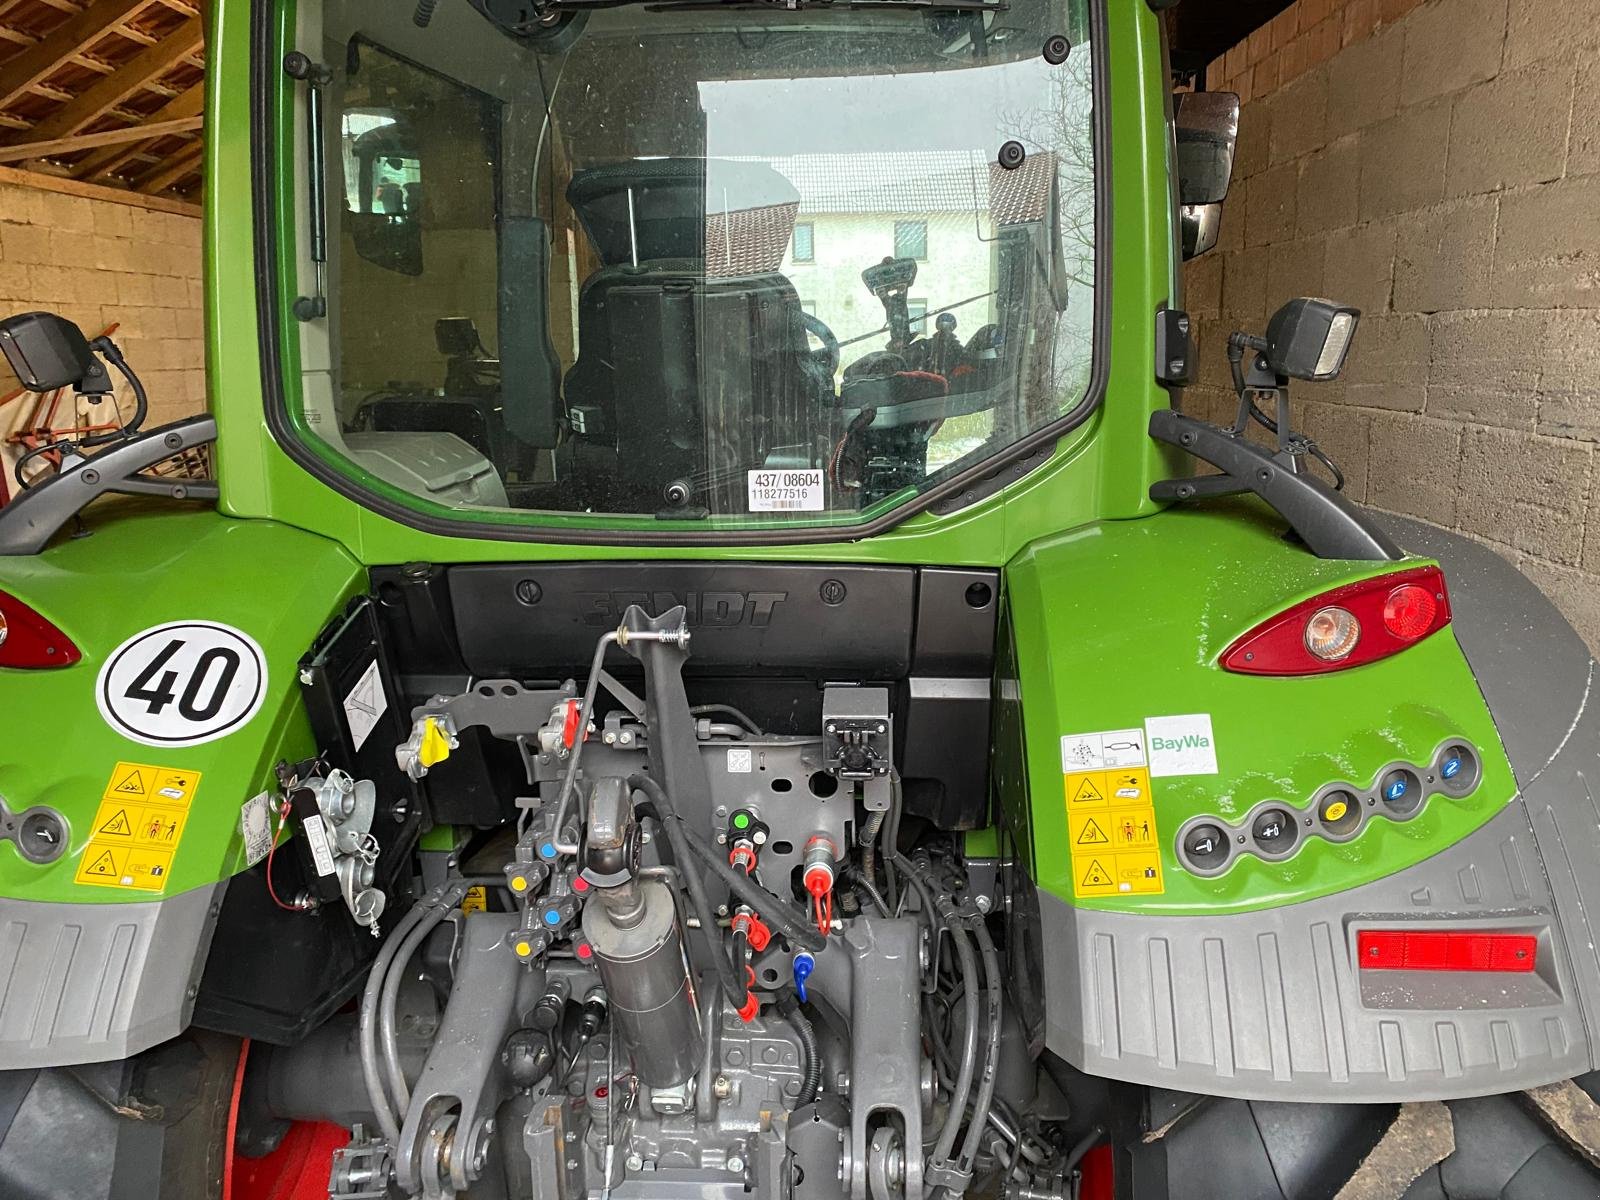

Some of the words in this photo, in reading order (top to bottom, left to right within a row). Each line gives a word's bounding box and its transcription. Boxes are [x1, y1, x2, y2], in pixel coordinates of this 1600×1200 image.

[752, 488, 808, 499] 118277516
[124, 639, 241, 722] 40
[1151, 734, 1210, 752] BayWa
